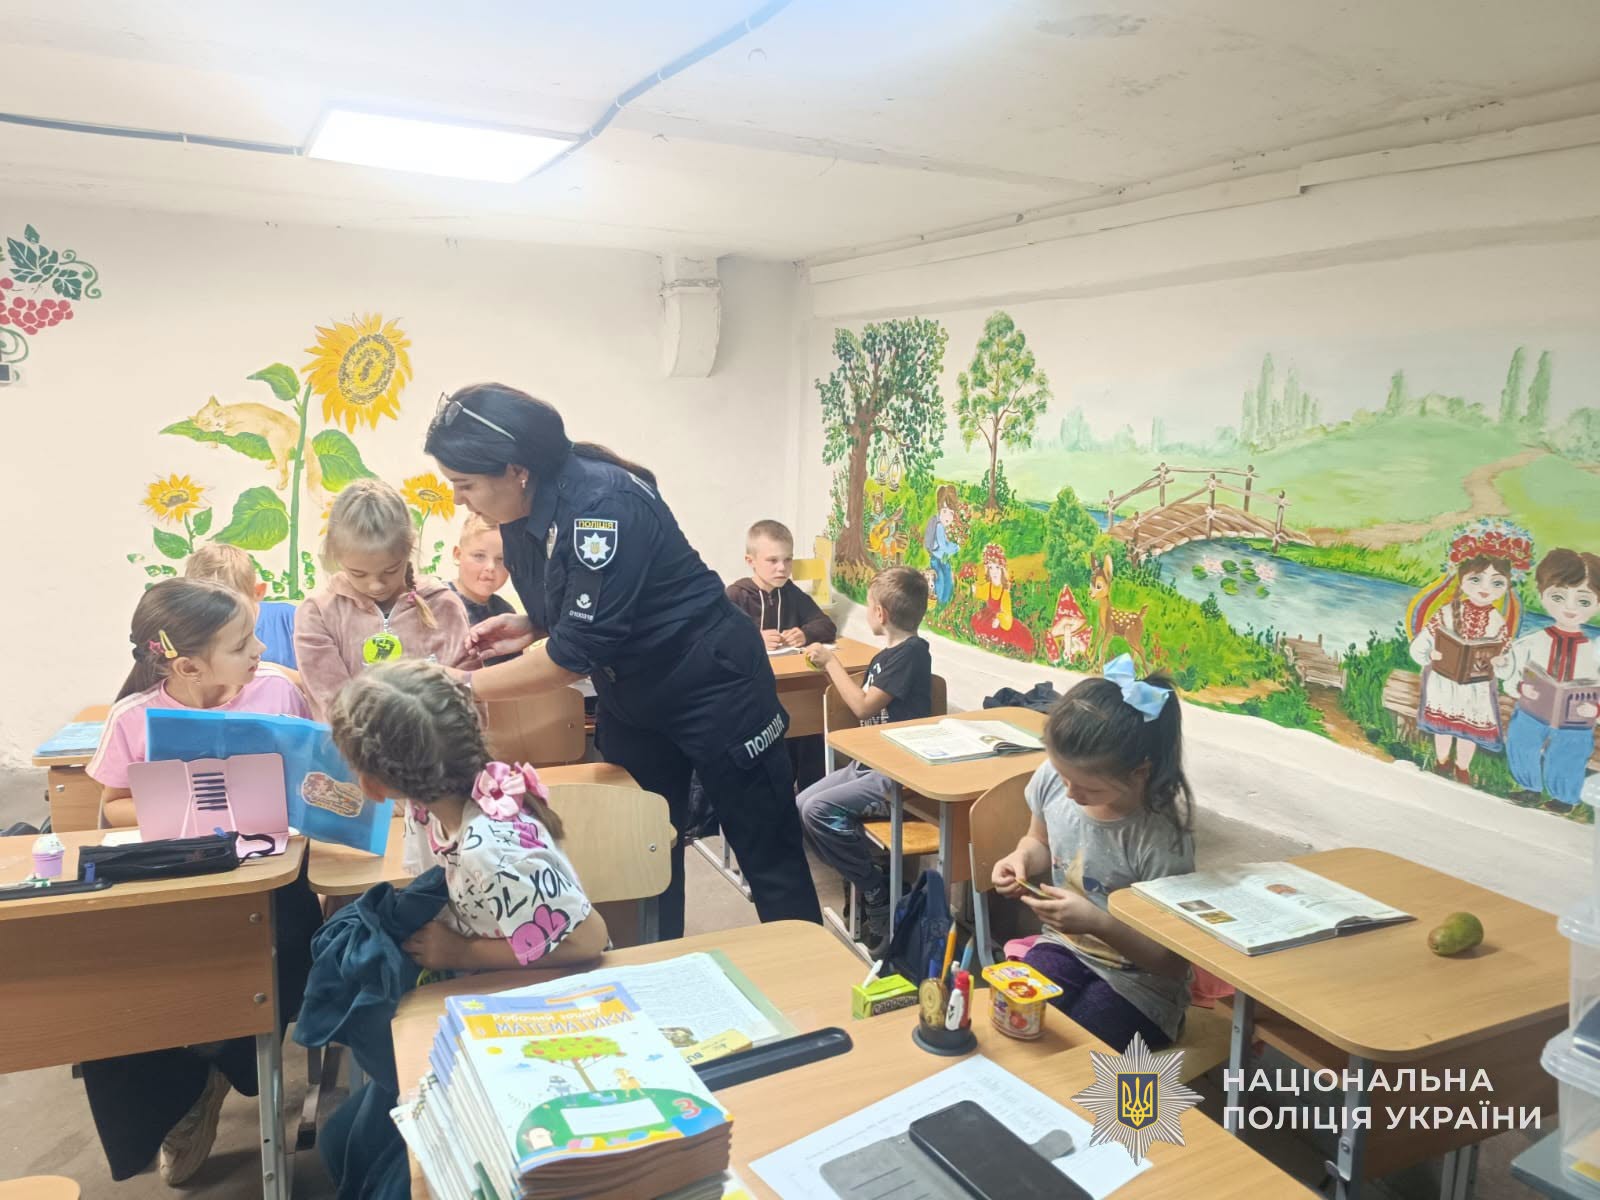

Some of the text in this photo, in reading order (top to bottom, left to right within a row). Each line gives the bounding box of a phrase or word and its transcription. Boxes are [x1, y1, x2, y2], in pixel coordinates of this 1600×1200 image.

[579, 520, 613, 529] ПОЛІЦІЯ
[744, 713, 784, 758] ПОЛІЦІЯ
[495, 1012, 633, 1035] МАТЕМАТИКИ
[673, 1098, 700, 1119] 3
